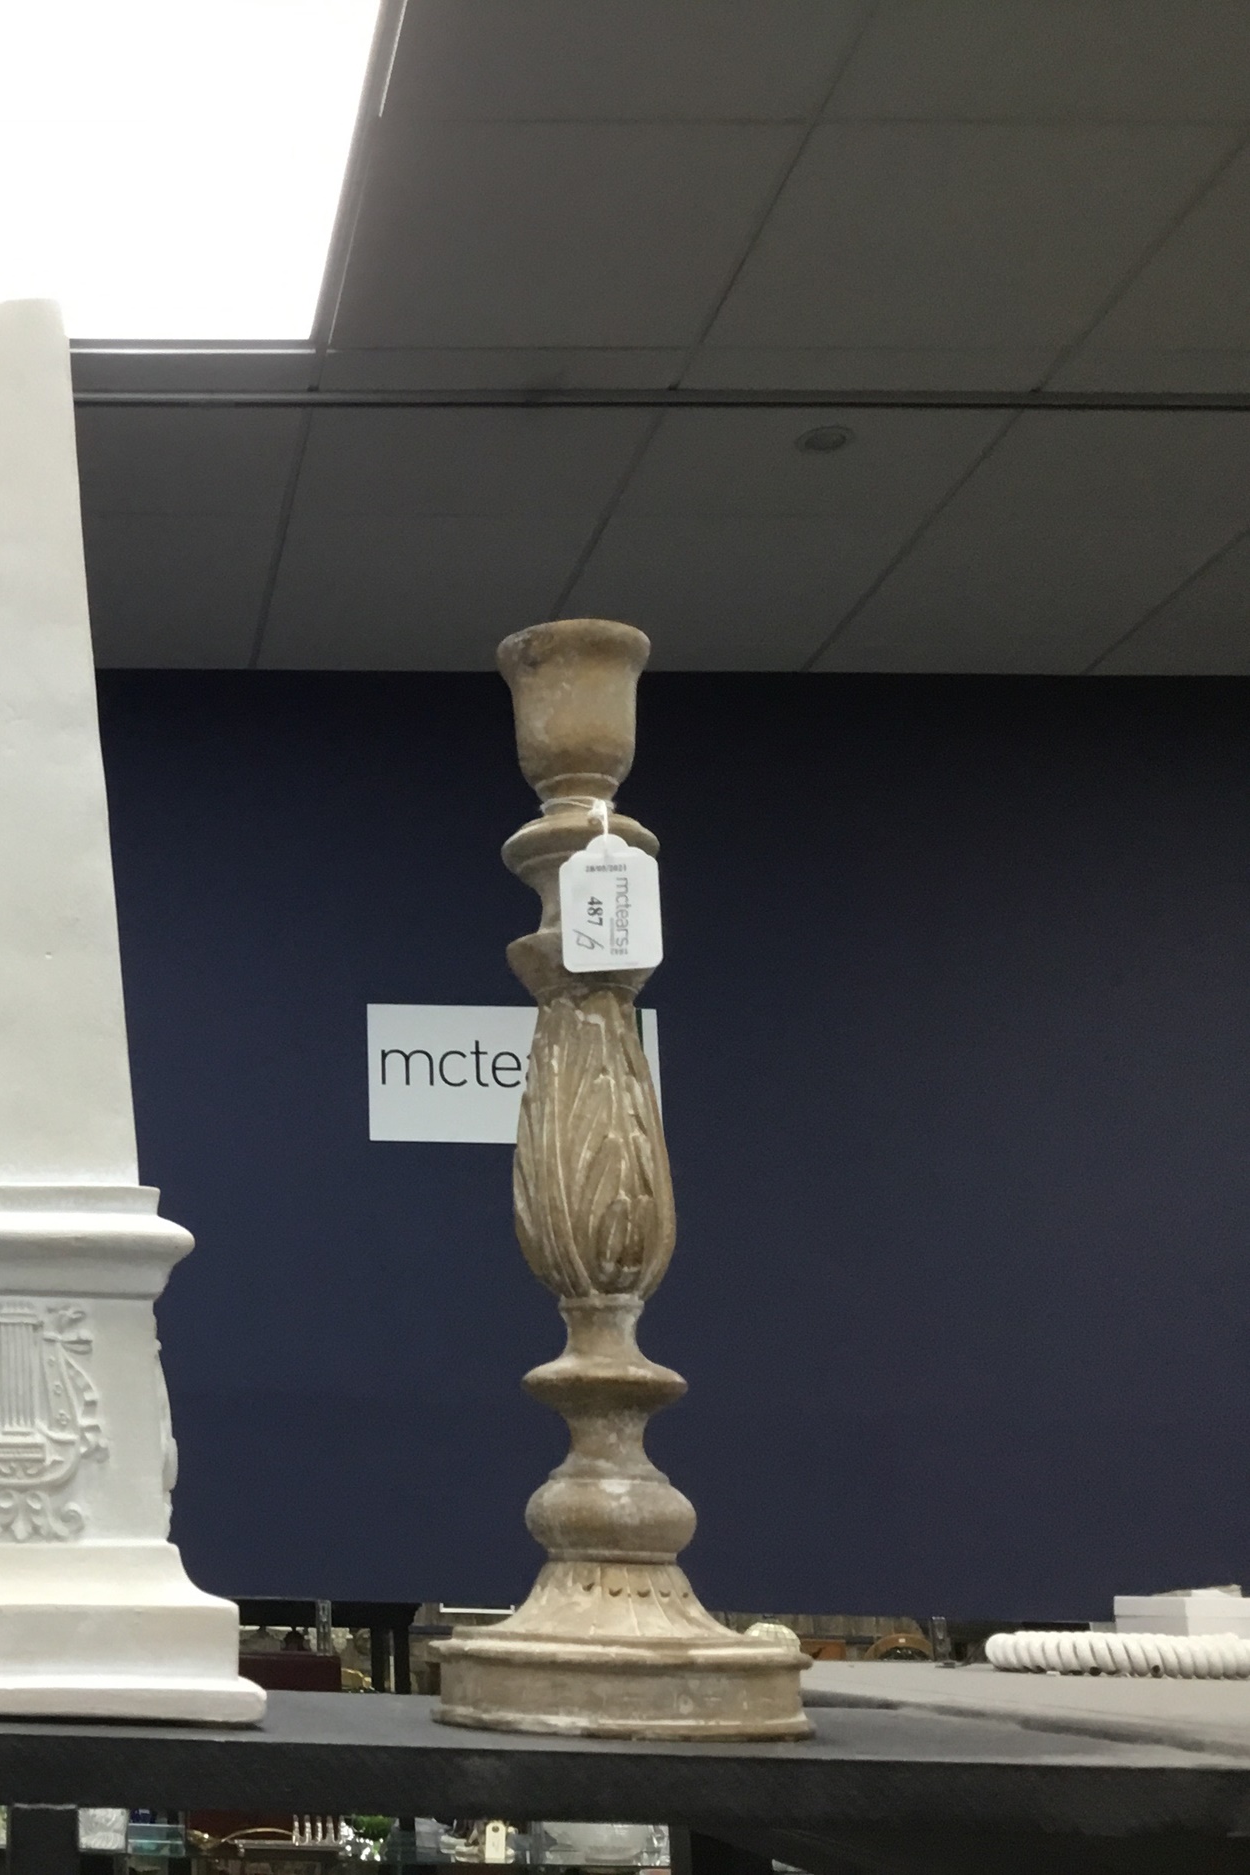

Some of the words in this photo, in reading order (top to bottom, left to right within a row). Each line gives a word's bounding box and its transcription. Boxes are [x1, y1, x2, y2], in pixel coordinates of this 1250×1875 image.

[587, 895, 604, 927] 487
[615, 876, 632, 948] mctears
[380, 1040, 533, 1089] mcte
